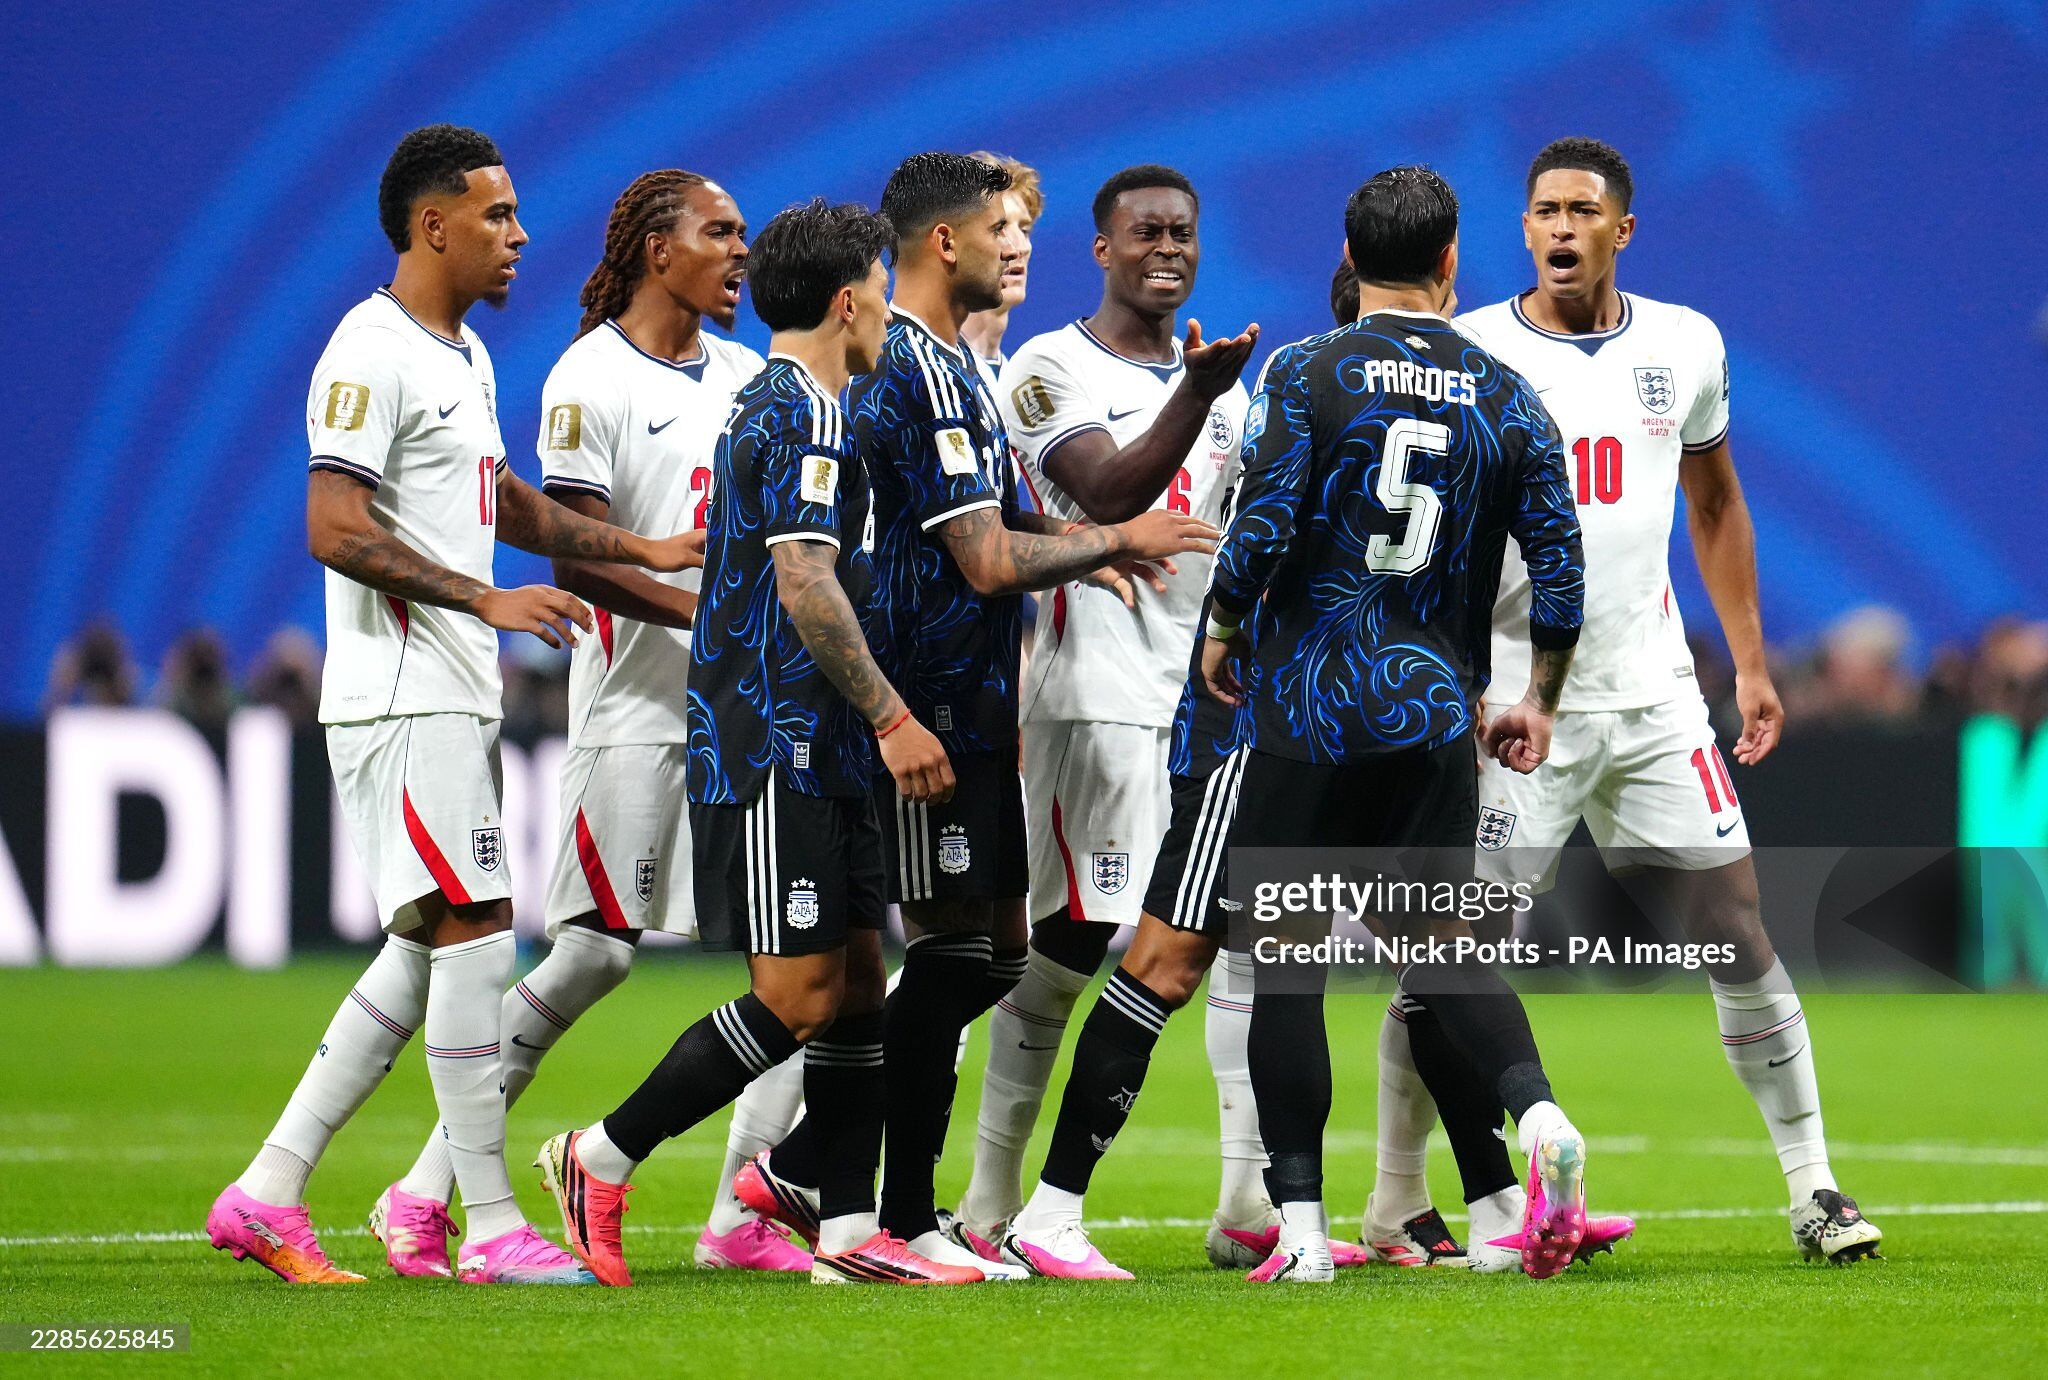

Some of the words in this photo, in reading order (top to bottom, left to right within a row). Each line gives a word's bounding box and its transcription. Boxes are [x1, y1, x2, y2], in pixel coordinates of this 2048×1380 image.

[1364, 359, 1477, 407] PAREDES
[1641, 417, 1676, 428] ARGENTINA
[478, 455, 495, 526] 17
[1167, 466, 1192, 517] 6
[1364, 417, 1452, 577] 5
[1571, 436, 1623, 505] 10
[1689, 743, 1738, 815] 10
